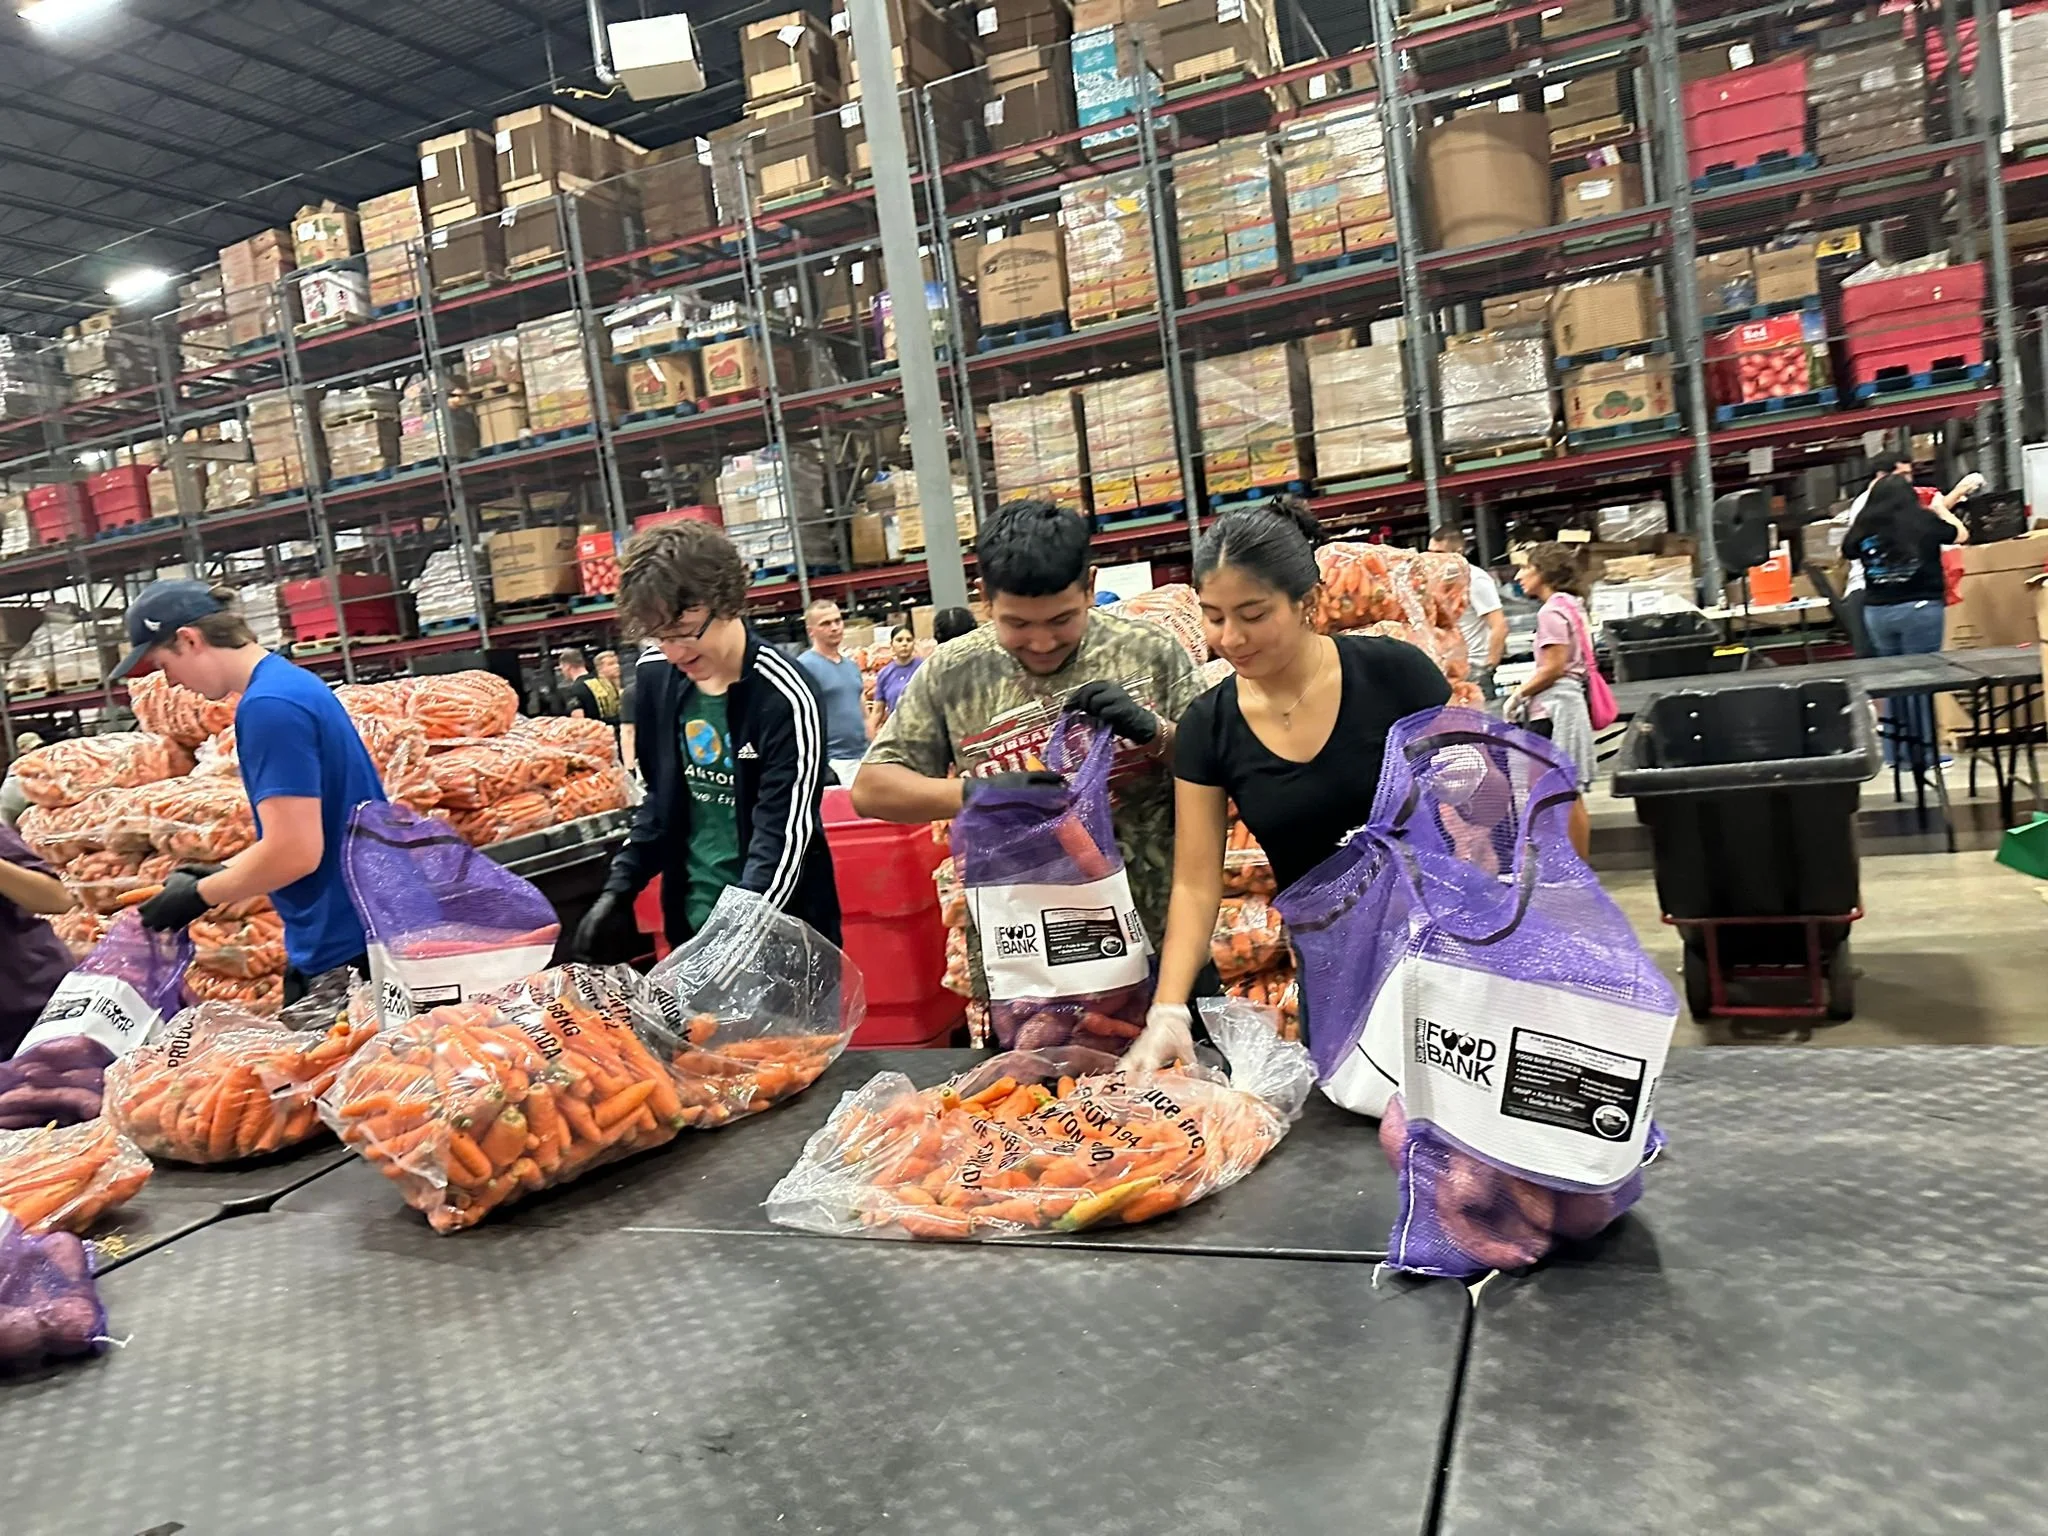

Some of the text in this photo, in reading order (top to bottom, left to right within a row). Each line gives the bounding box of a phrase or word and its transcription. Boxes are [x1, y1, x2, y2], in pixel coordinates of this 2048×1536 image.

[1000, 923, 1036, 940] FOOD
[1002, 938, 1039, 955] BANK
[1426, 1021, 1497, 1062] FOOD
[1427, 1042, 1495, 1087] BANK
[1109, 1125, 1143, 1149] 194
